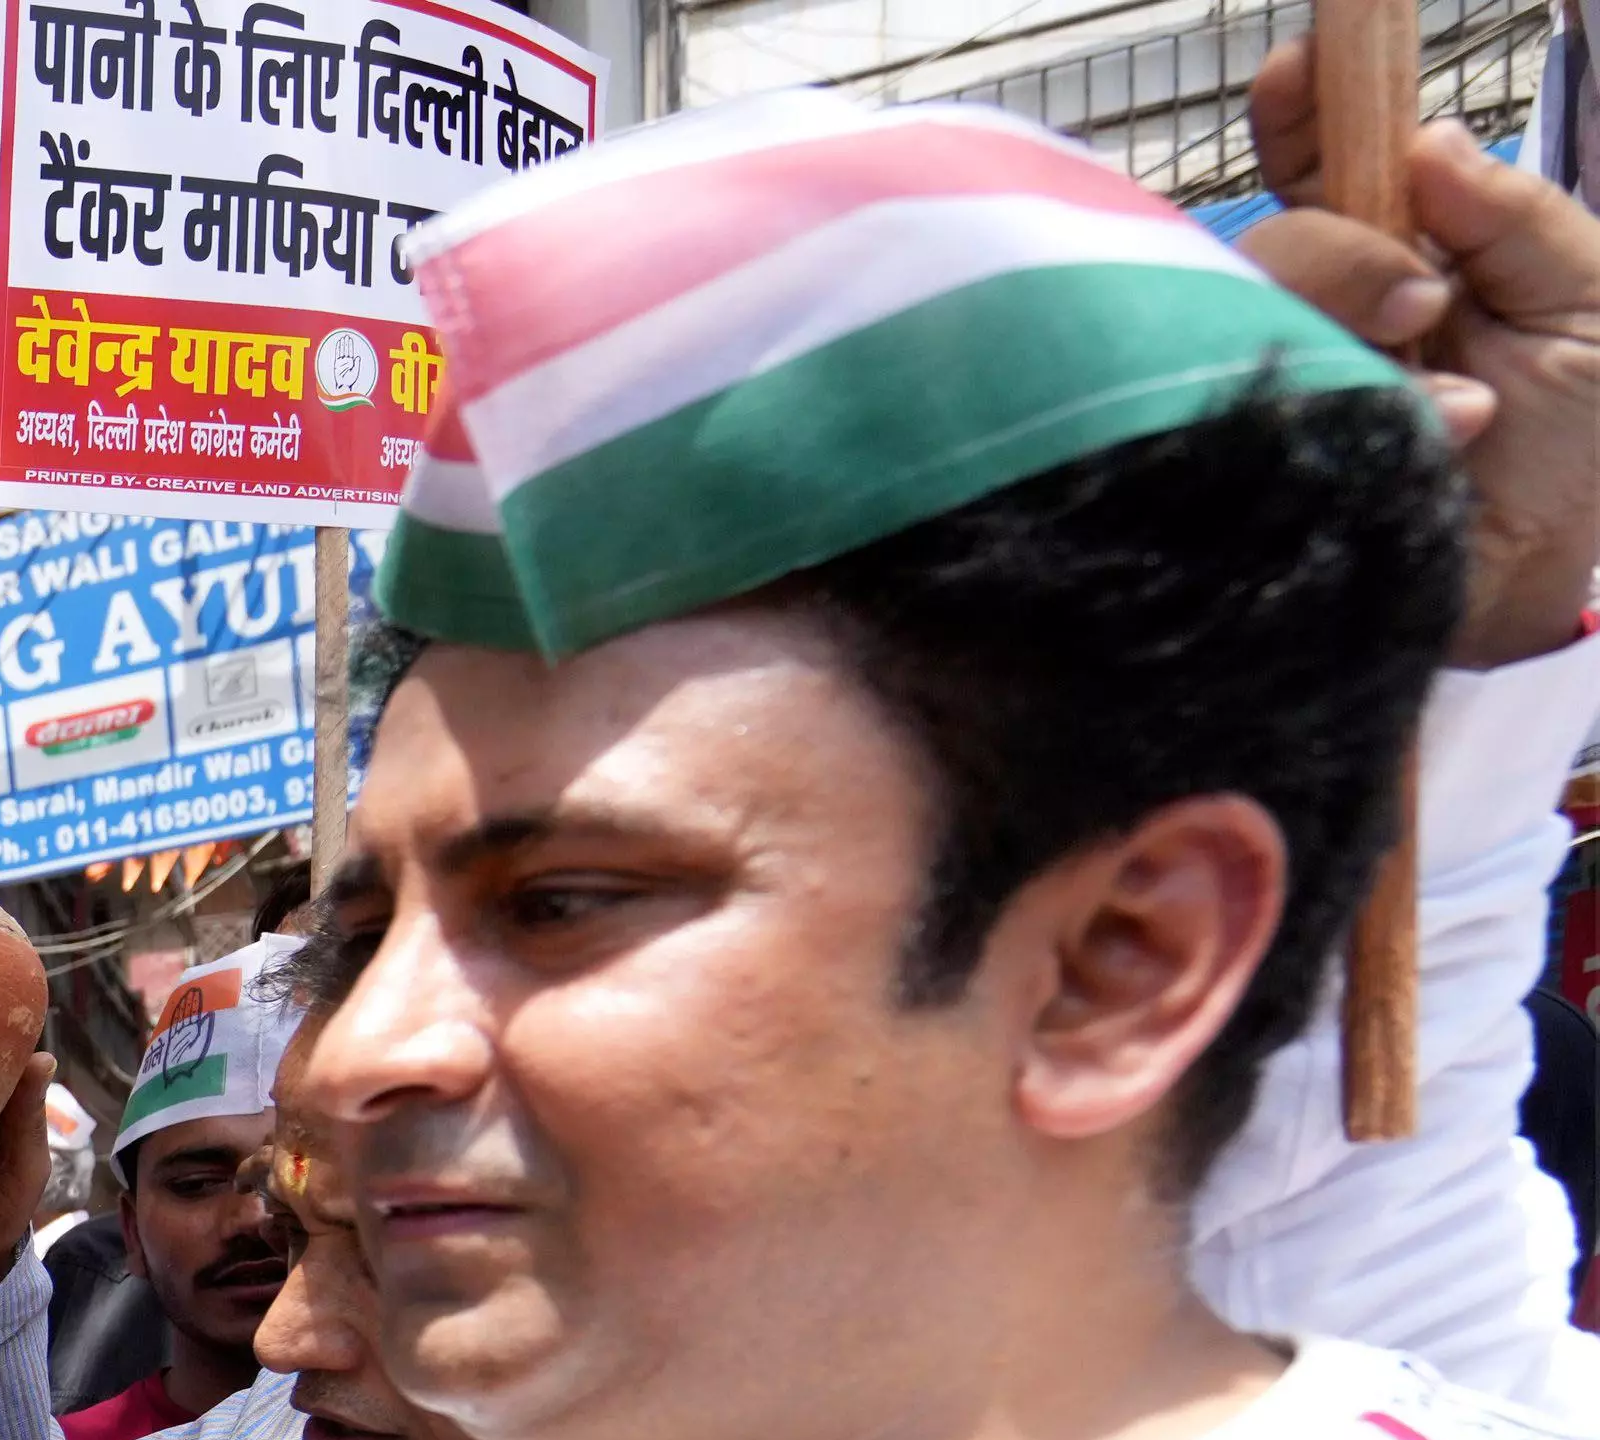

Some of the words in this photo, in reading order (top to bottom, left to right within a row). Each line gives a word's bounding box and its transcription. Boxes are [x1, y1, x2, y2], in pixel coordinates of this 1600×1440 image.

[169, 0, 227, 117] के
[235, 2, 346, 133] लिए
[353, 18, 488, 166] दिल्ली
[39, 130, 172, 267] टैंकर
[180, 153, 380, 288] माफिया
[15, 295, 161, 399] देवेन्द्र
[168, 327, 311, 401] यादव
[15, 409, 80, 457] अध्यक्ष,
[86, 399, 139, 453] दिल्ली
[143, 404, 185, 455] प्रदेश
[190, 407, 245, 458] कांग्रेस
[250, 411, 302, 463] कमेटी
[25, 469, 106, 487] PRINTED
[110, 474, 141, 489] BY-
[146, 477, 236, 495] CREATIVE
[240, 481, 291, 497] LAND
[29, 539, 139, 598] WALI
[151, 520, 254, 568] GALI
[93, 761, 197, 807] Mandir
[203, 745, 272, 783] Wali
